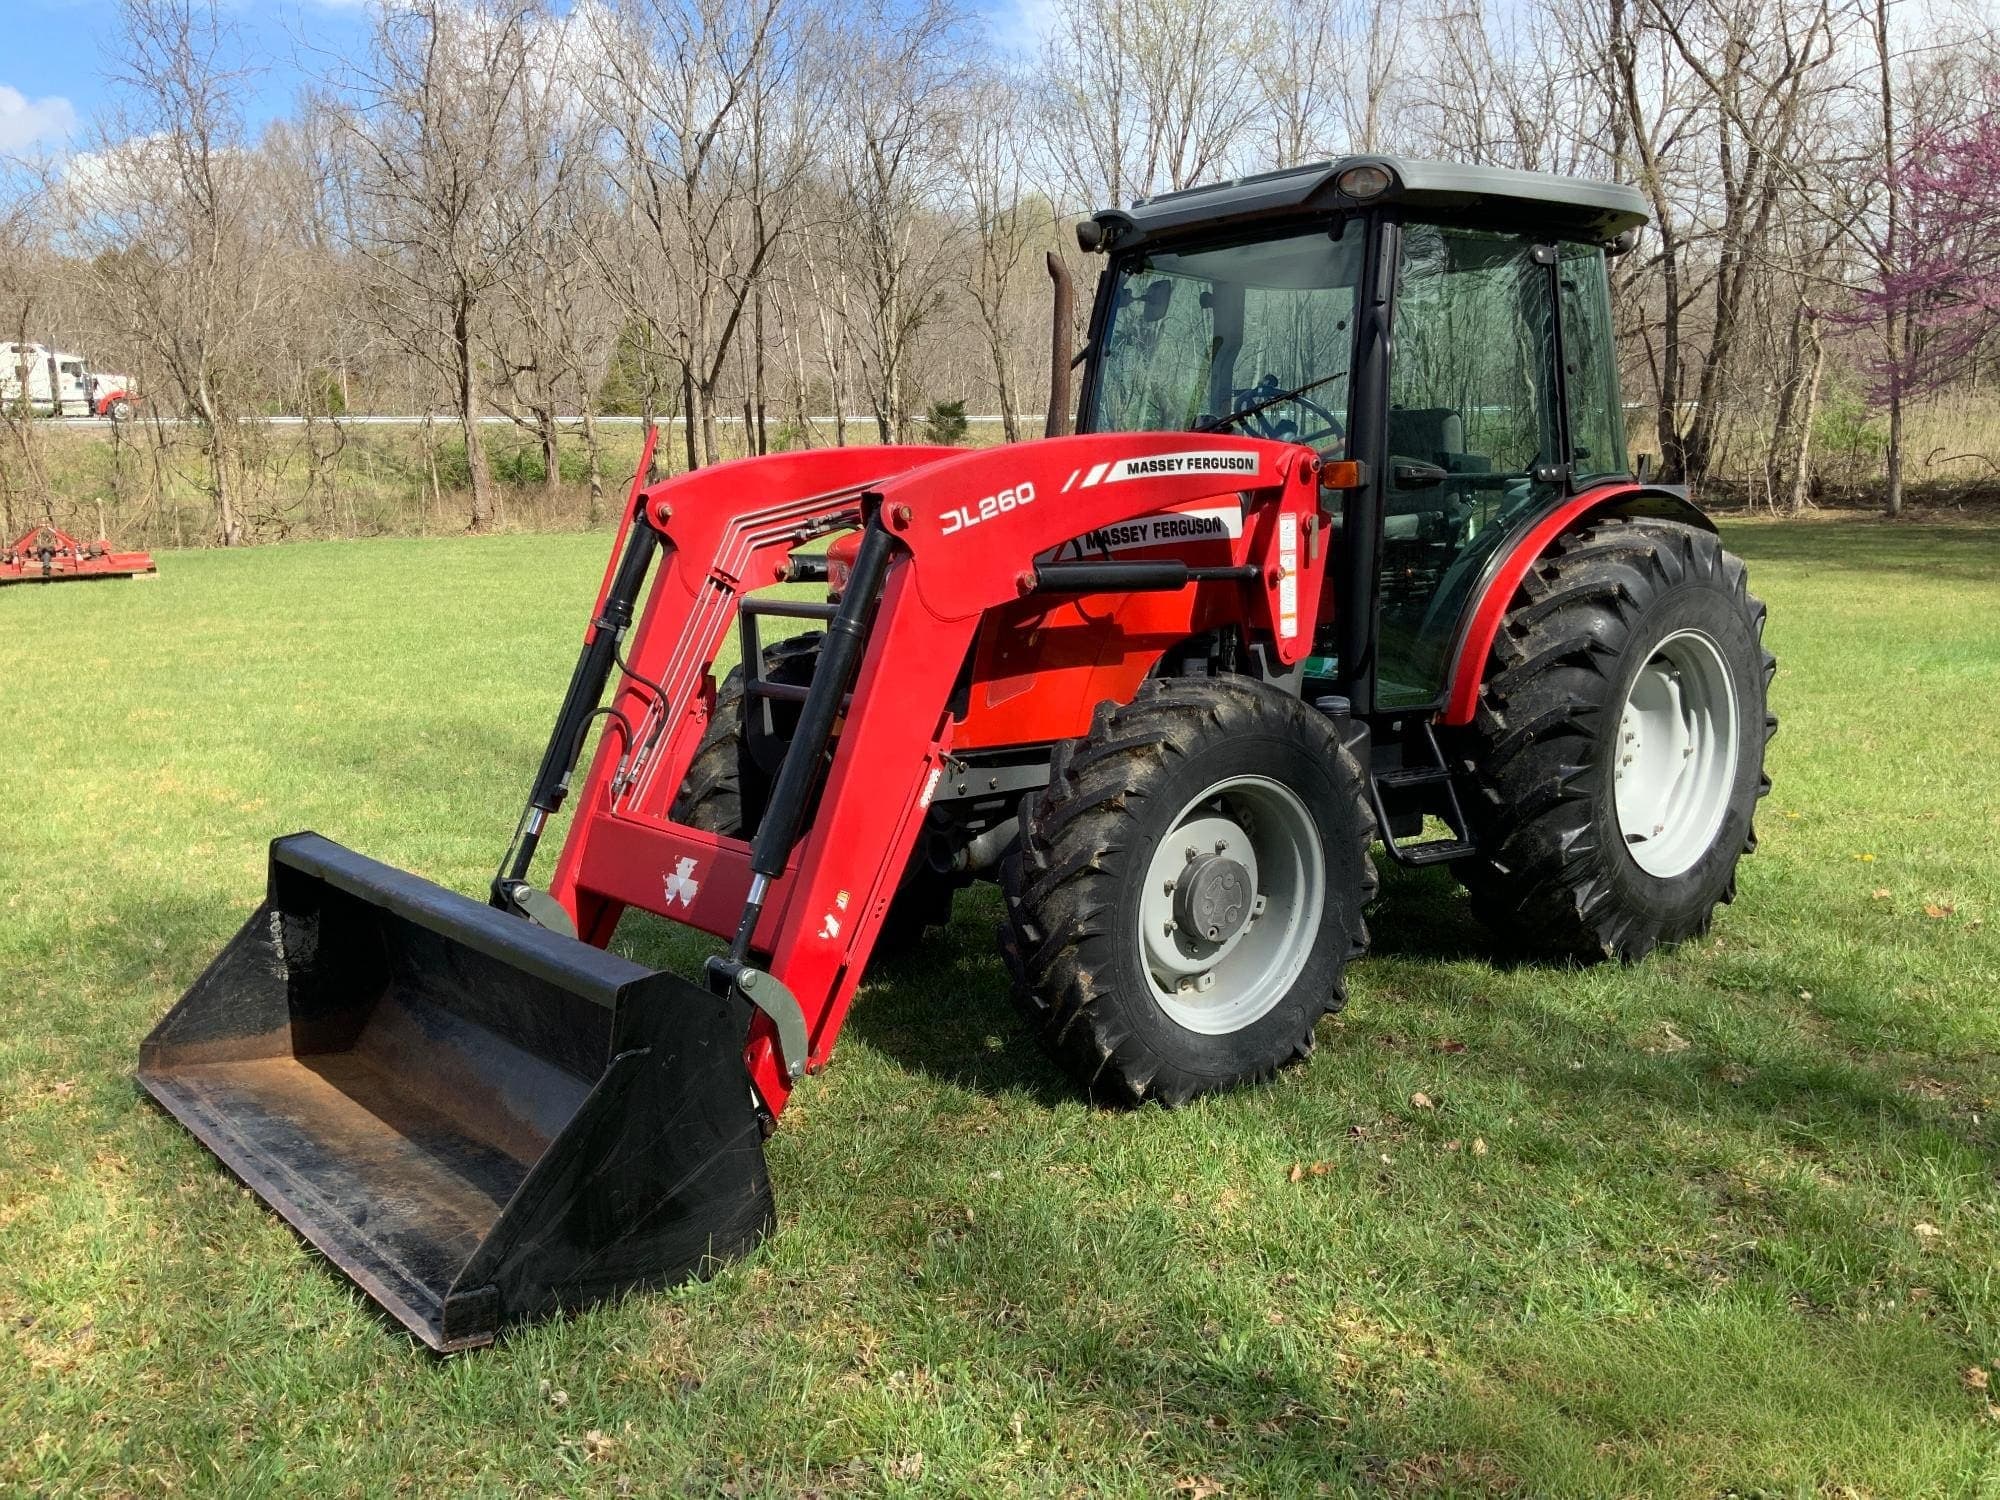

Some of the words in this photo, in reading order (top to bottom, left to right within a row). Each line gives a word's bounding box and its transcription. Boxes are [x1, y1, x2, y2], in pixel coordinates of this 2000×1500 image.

[1127, 459, 1183, 475] MASSEY
[1187, 457, 1254, 470] FERGUSON
[939, 481, 1036, 536] DL260
[1152, 515, 1222, 539] FERGUSON
